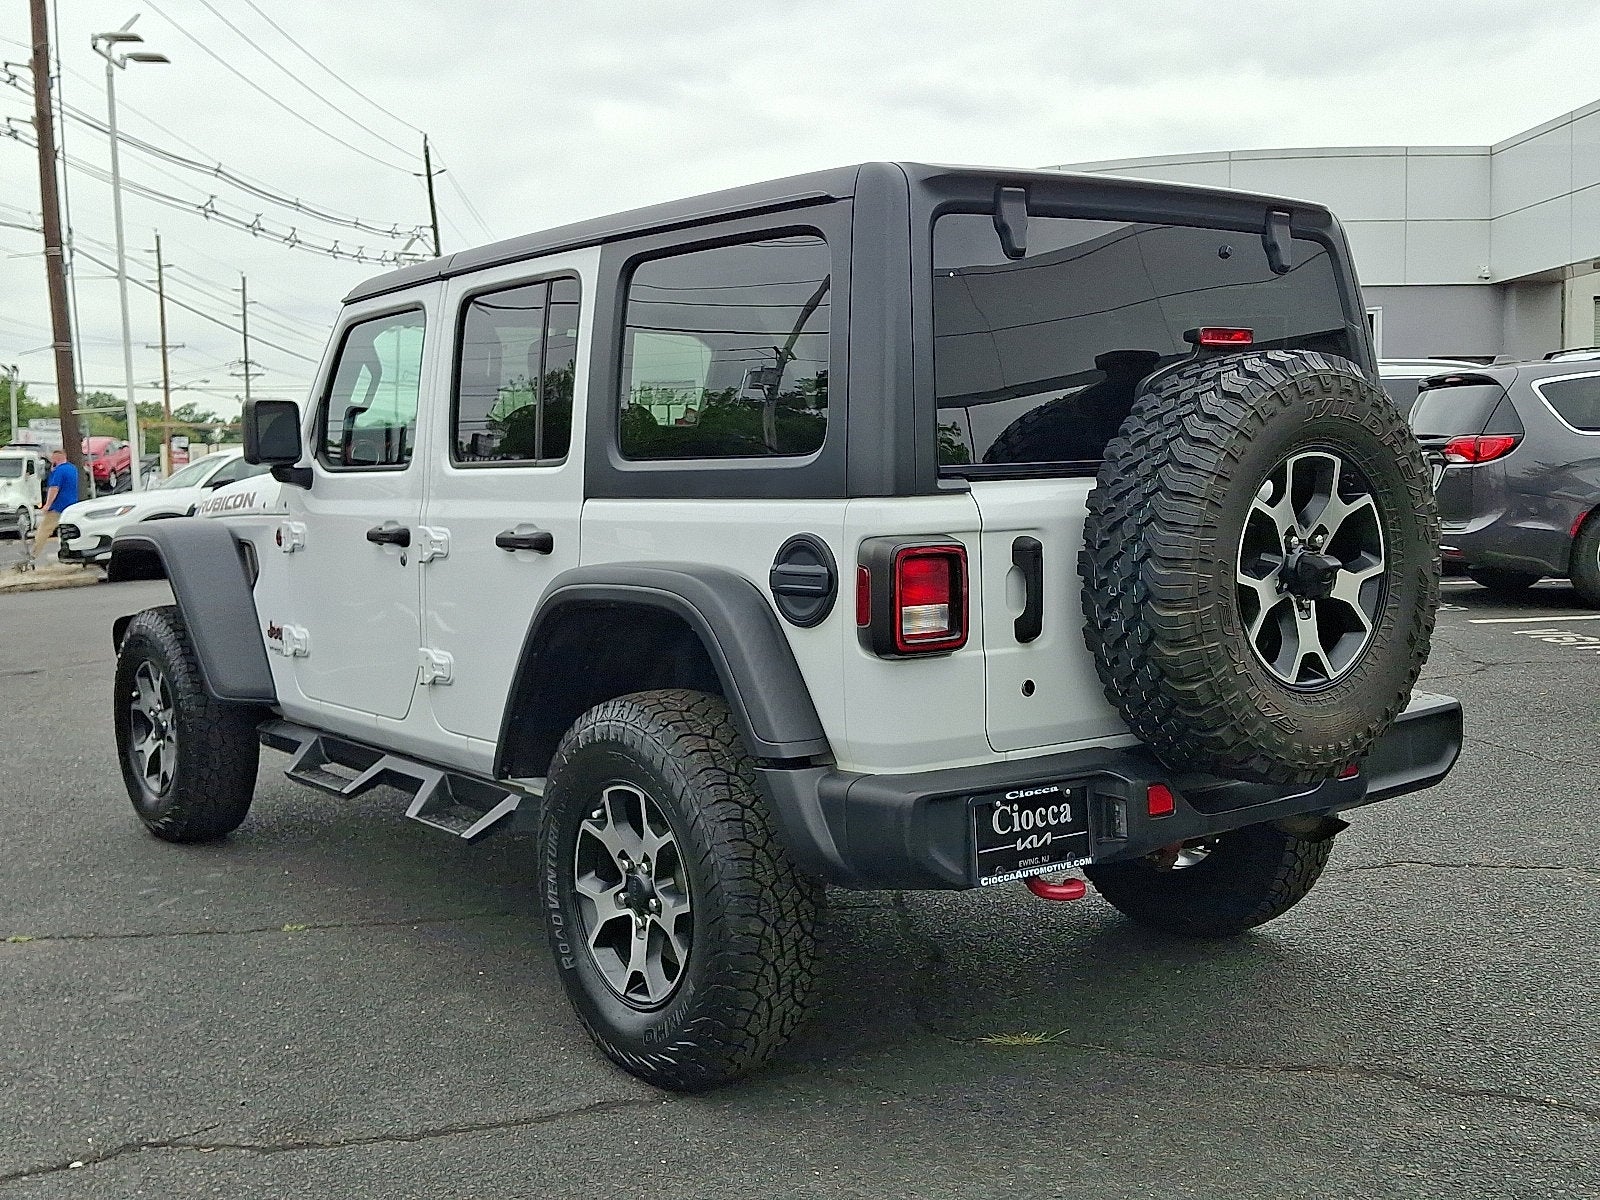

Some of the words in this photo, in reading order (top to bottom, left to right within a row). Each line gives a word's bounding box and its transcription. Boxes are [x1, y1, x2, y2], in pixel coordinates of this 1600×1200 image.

[198, 491, 257, 514] RUBICON
[1005, 785, 1059, 800] Ciocca
[992, 803, 1073, 835] Ciocca
[545, 814, 562, 911] VENTURE
[1041, 855, 1050, 863] NJ
[551, 913, 577, 971] ROAD
